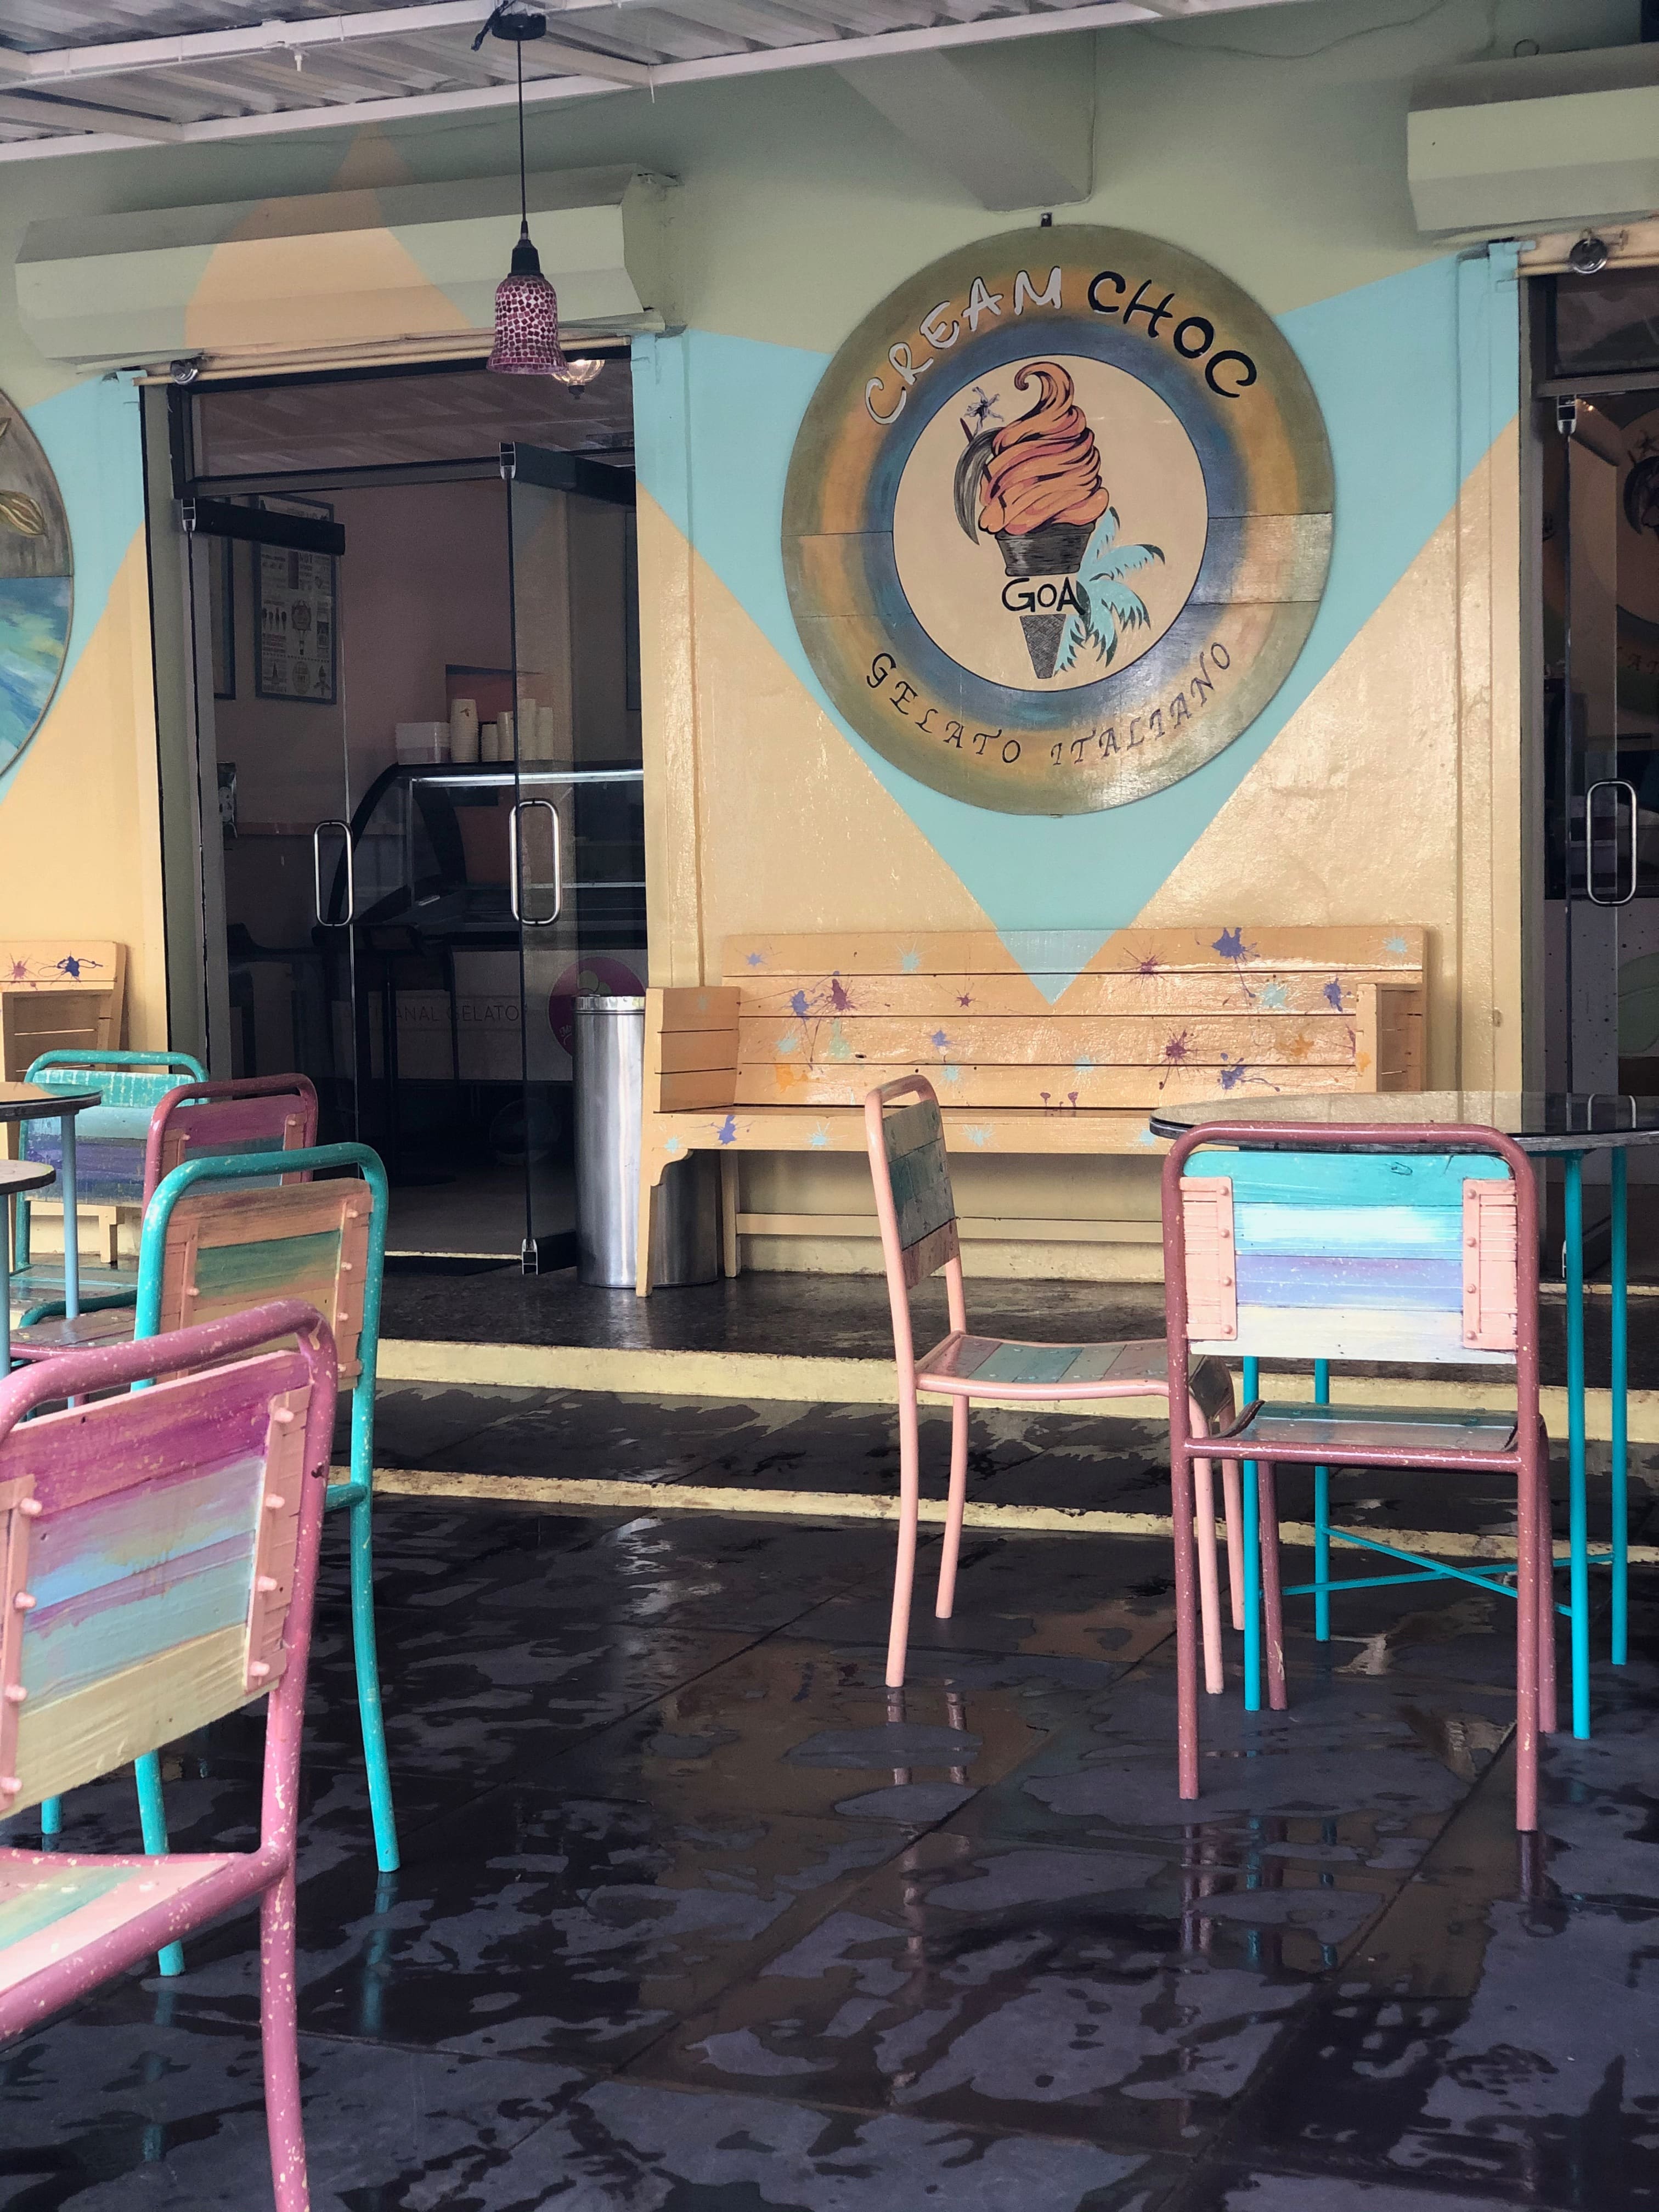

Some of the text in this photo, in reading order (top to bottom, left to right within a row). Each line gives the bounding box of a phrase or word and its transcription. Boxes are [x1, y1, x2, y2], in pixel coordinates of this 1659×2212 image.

[865, 266, 1257, 425] CREAM CHOC
[1002, 577, 1086, 615] GOA
[866, 642, 1231, 766] GELATO ITALIANO
